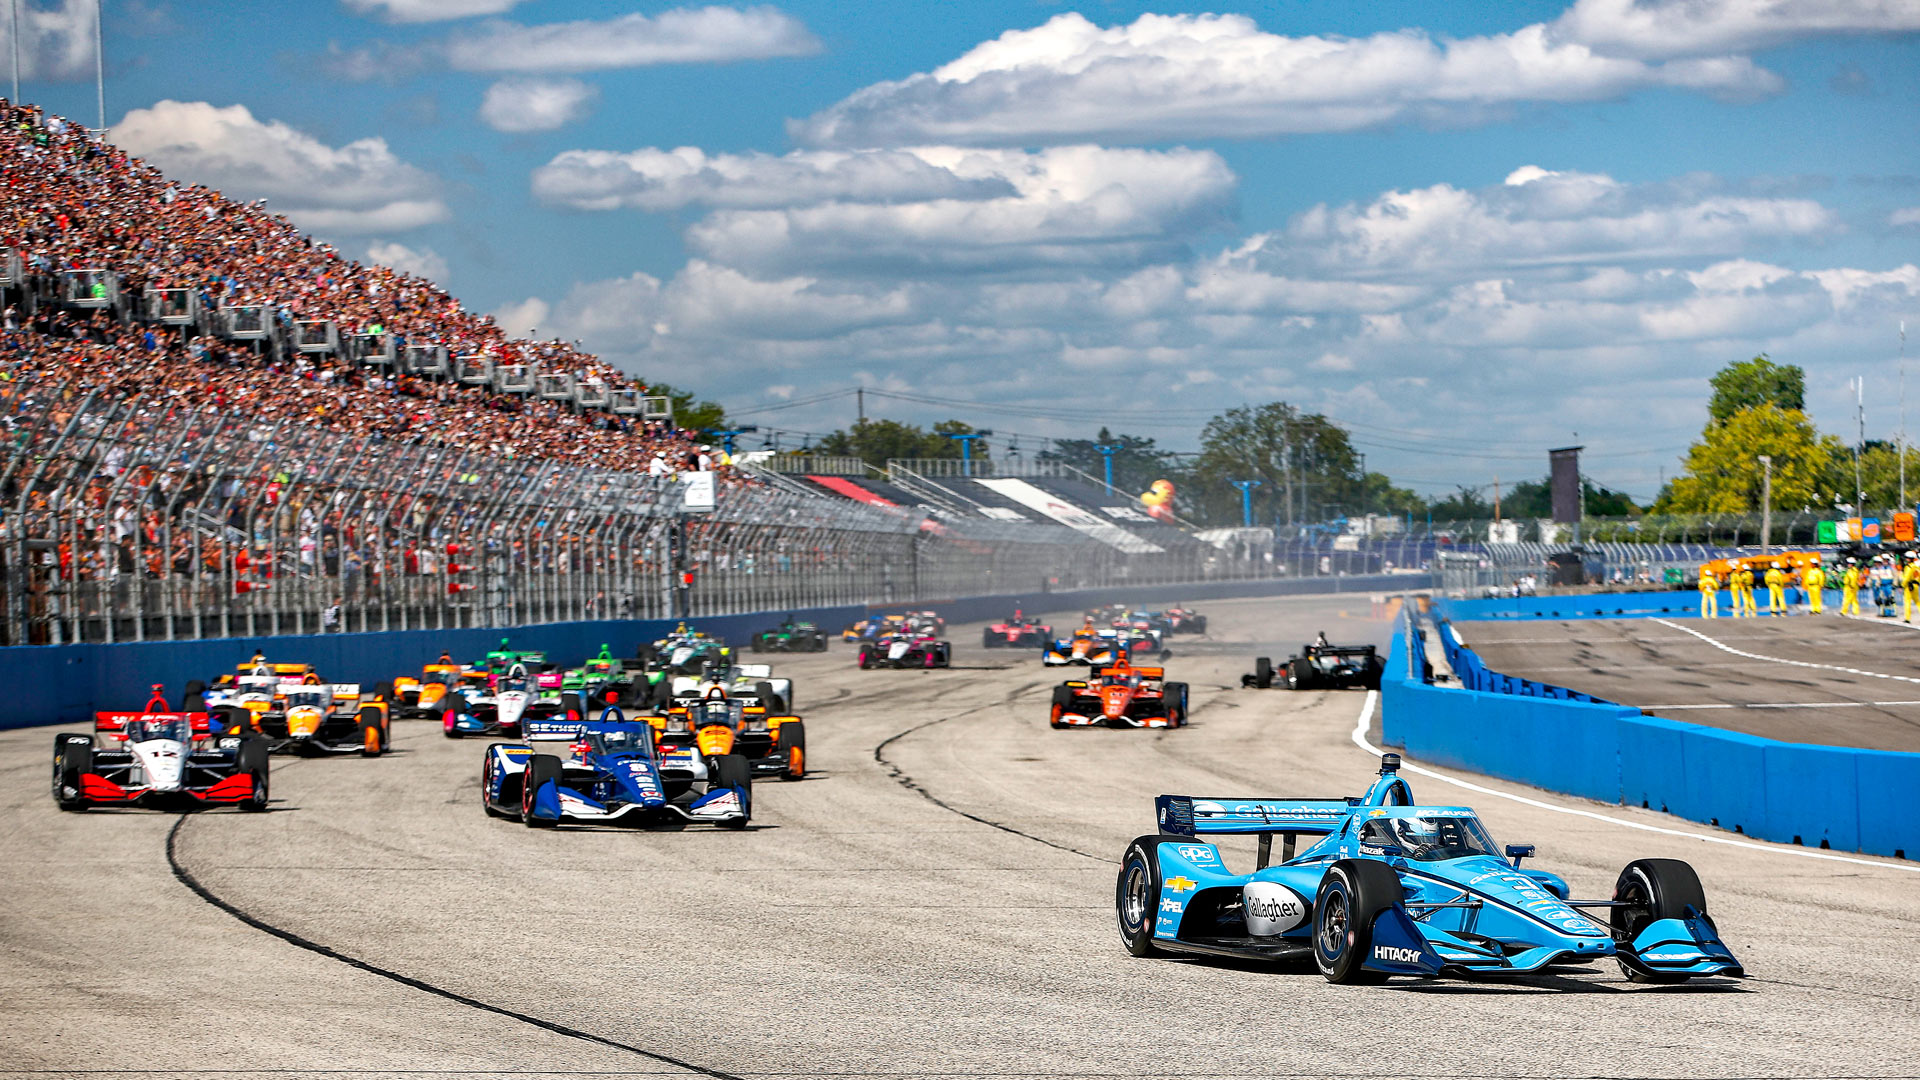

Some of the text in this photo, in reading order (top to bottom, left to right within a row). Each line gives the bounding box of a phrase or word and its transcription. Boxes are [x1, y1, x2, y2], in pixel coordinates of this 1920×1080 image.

[1234, 804, 1339, 819] Gallagher
[1181, 848, 1212, 861] PPG
[1162, 898, 1183, 913] XPEL
[1248, 896, 1299, 922] Gallagher
[1374, 945, 1422, 962] HITACHI
